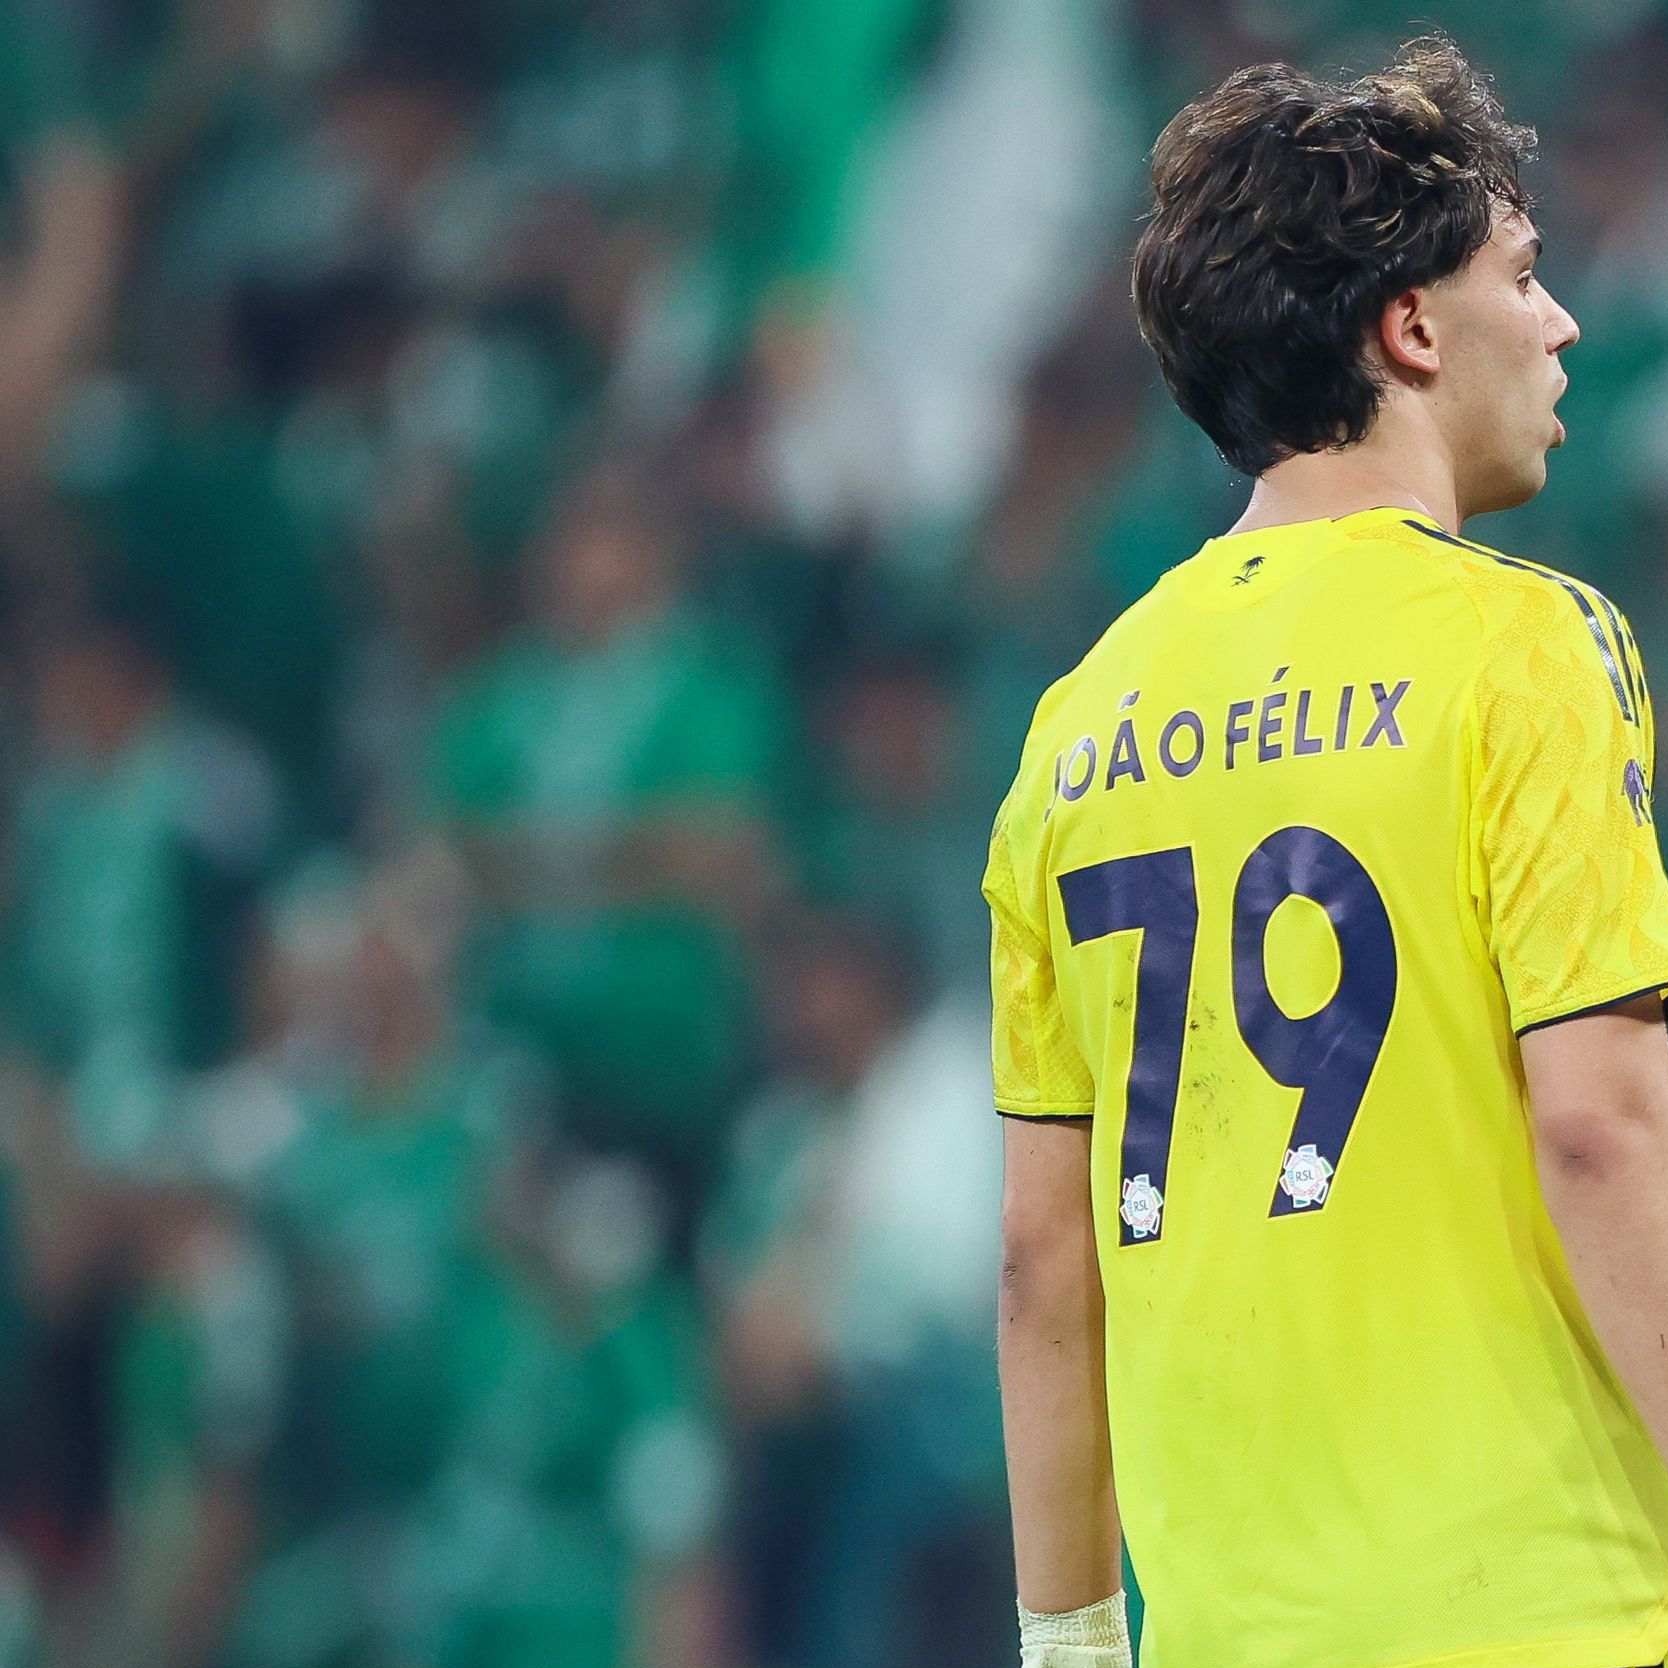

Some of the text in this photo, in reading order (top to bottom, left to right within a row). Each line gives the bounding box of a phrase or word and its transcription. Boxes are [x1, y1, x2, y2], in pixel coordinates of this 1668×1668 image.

[1043, 665, 1413, 823] JOÃO FÉLIX
[1056, 826, 1397, 1246] 79
[1133, 1199, 1149, 1212] RSL
[1294, 1169, 1315, 1182] RSL
